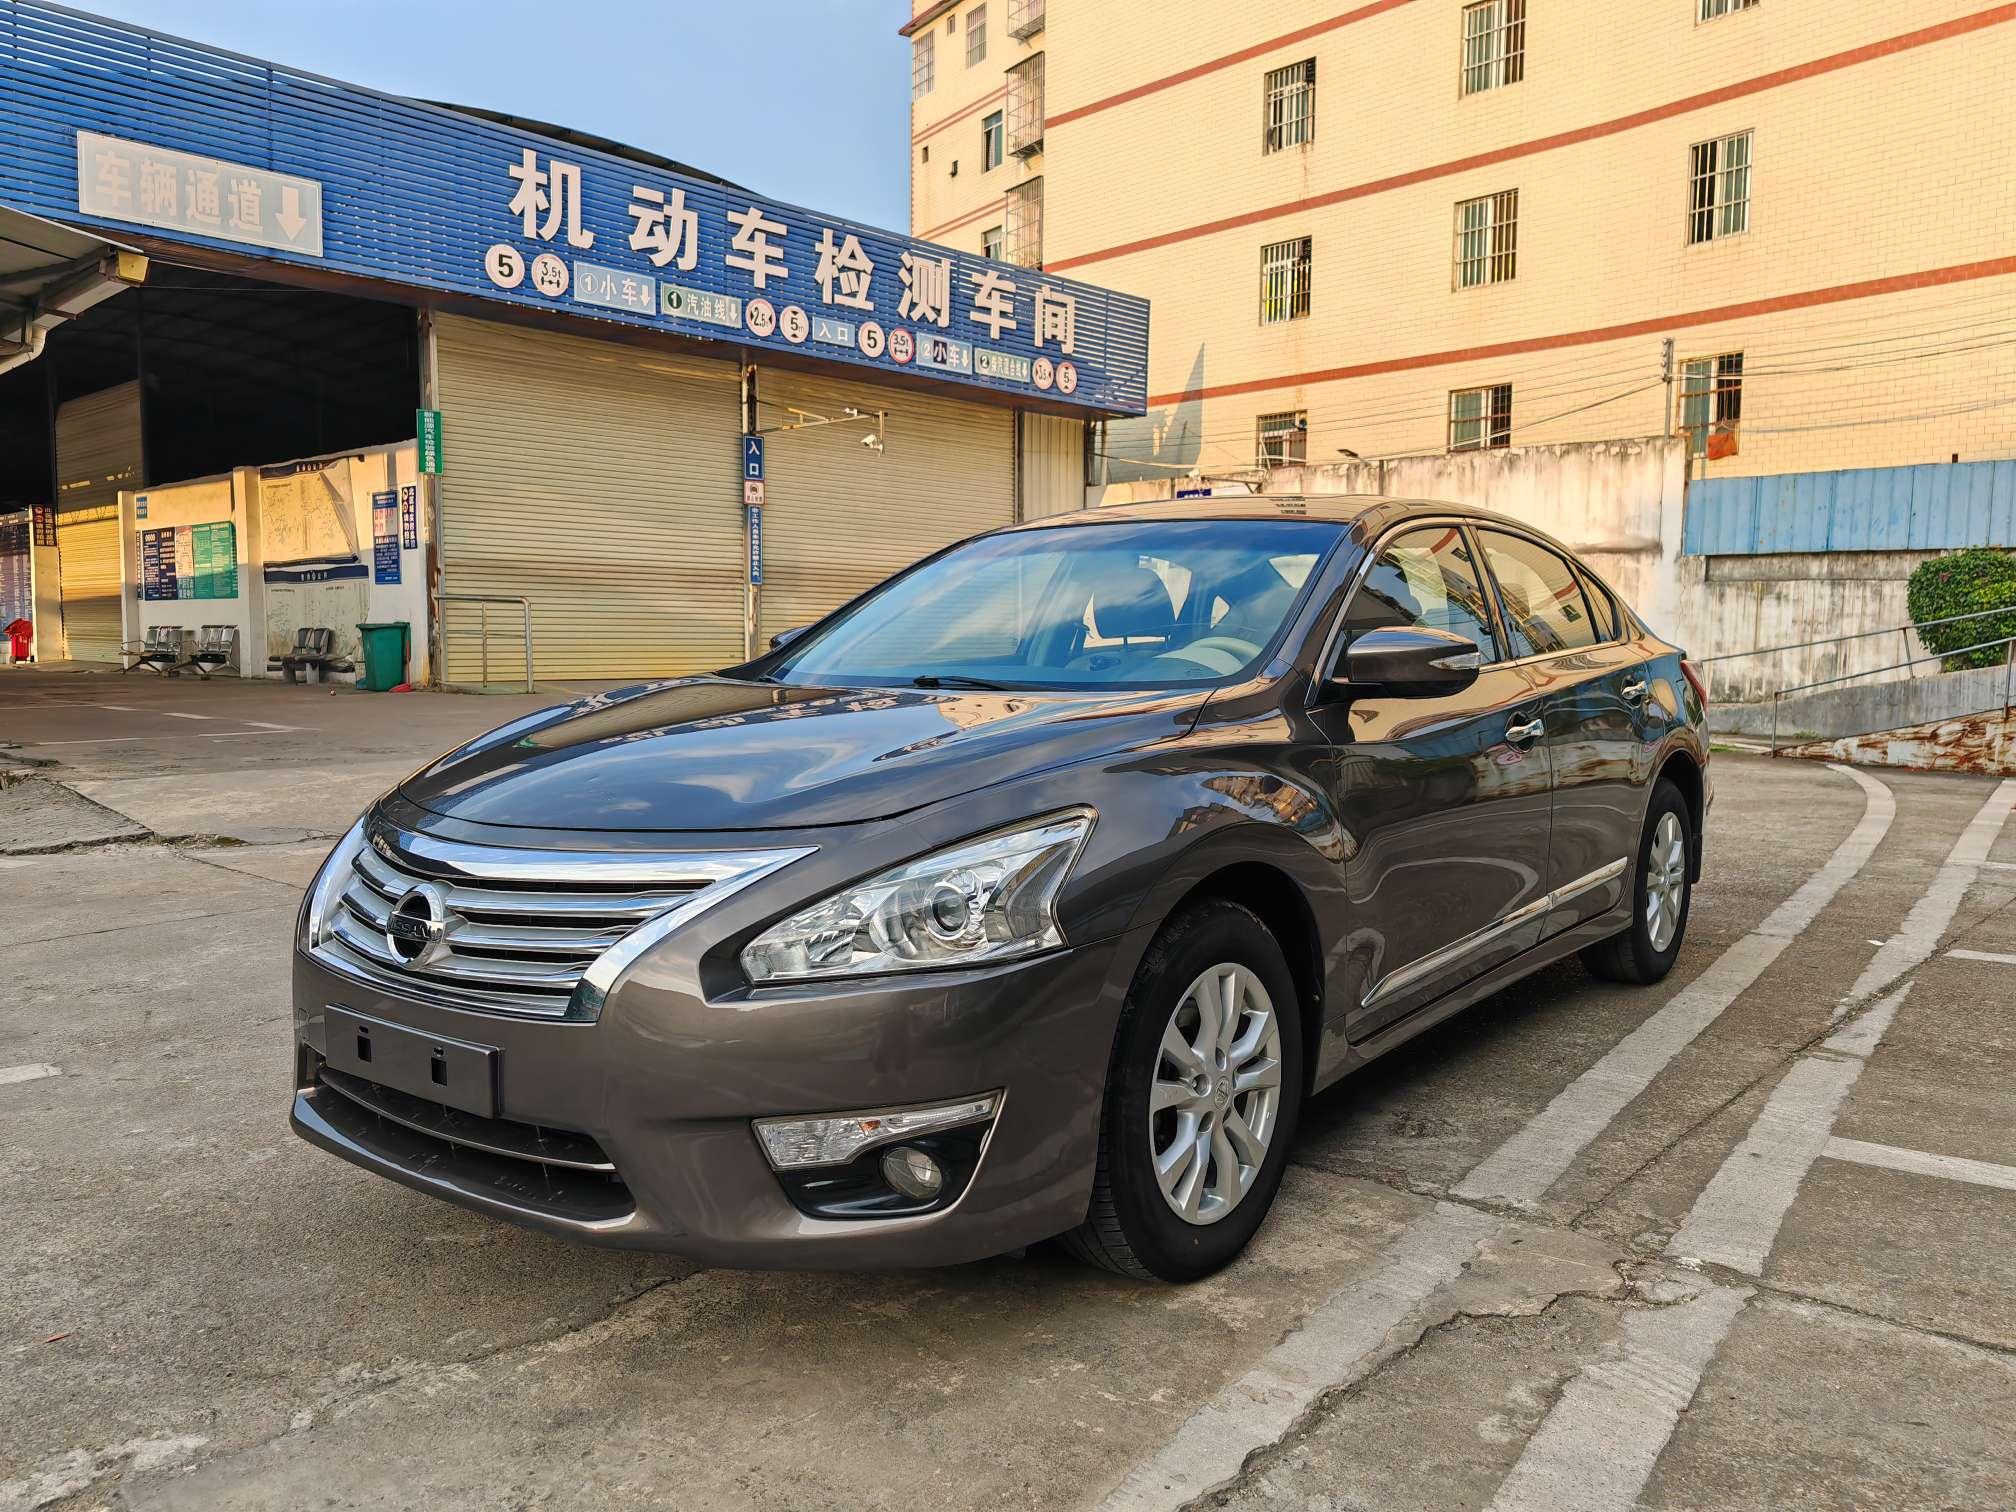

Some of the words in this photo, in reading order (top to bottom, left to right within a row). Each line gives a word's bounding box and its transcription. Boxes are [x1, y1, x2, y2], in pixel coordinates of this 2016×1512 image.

[95, 151, 264, 232] 车辆通道
[498, 253, 514, 278] 5
[508, 148, 1076, 354] 机动车检测车间
[819, 322, 848, 342] 入口
[867, 330, 877, 349] 5
[748, 441, 760, 476] 入口
